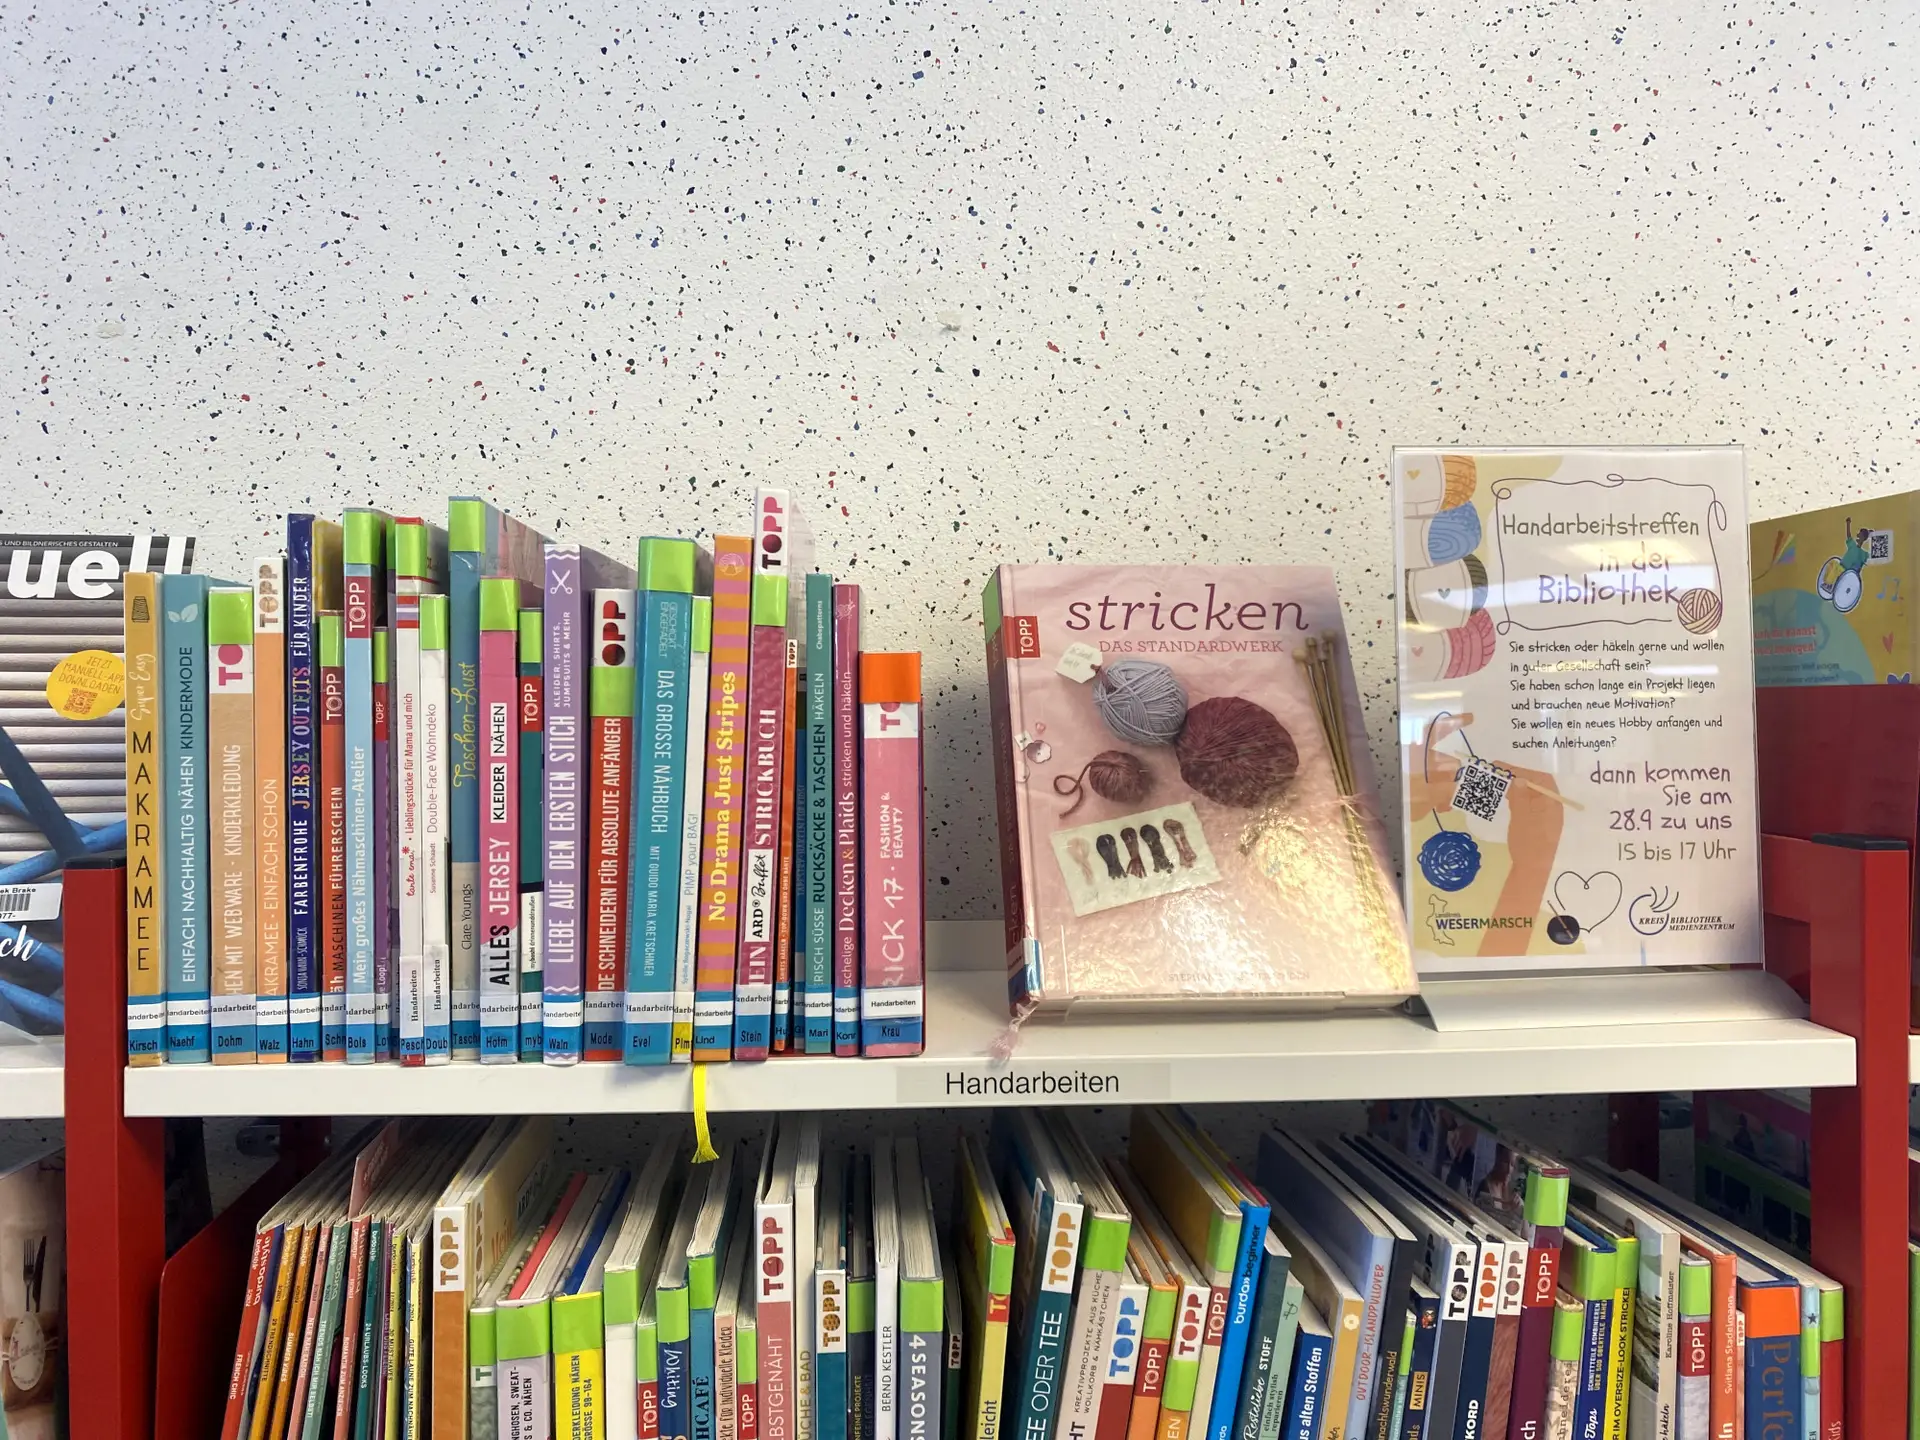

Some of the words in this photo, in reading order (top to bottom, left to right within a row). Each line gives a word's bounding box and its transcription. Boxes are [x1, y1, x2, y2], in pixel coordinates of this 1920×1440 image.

[22, 541, 78, 549] BILDNERISCHES
[762, 496, 783, 570] TOPP
[1502, 511, 1700, 536] Handarbeitstreffen
[1599, 549, 1620, 573] in
[1632, 541, 1670, 573] der
[258, 564, 279, 629] TOPP
[292, 577, 308, 627] KINDER
[349, 582, 366, 632] TOPP
[1065, 583, 1310, 631] stricken
[1539, 573, 1680, 605] Bibliothek
[553, 622, 562, 660] SHIRTS,
[564, 612, 572, 639] MEHR
[1098, 640, 1134, 653] DAS
[1137, 639, 1286, 653] STANDARDWERK
[1509, 641, 1525, 653] Sie
[1528, 641, 1571, 653] stricken
[1575, 640, 1599, 652] oder
[1602, 641, 1635, 653] häkeln
[1638, 641, 1667, 658] gerne
[1670, 640, 1689, 652] und
[1692, 640, 1725, 652] wollen
[58, 672, 121, 695] DOWNLOADEN
[553, 663, 562, 708] KLEIDER,
[564, 652, 572, 709] JUMPSUITS
[657, 670, 675, 699] DAS
[1510, 661, 1520, 673] in
[1523, 661, 1553, 677] guter
[1555, 657, 1622, 673] Gesellschaft
[1624, 659, 1652, 672] sein?
[1510, 679, 1526, 692] Sie
[1529, 679, 1561, 692] haben
[1564, 679, 1595, 691] schon
[1598, 679, 1625, 695] lange
[1628, 679, 1643, 691] ein
[1646, 678, 1684, 694] Projekt
[1687, 678, 1716, 694] liegen
[178, 647, 196, 750] KINDERMODE
[291, 667, 311, 736] OUTFITS
[326, 673, 342, 721] TOPP
[524, 683, 538, 724] TOPP
[715, 671, 739, 750] Stripes
[812, 673, 826, 720] HÄKELN
[1511, 698, 1530, 711] und
[1534, 698, 1583, 711] brauchen
[1586, 700, 1611, 710] neue
[1614, 697, 1676, 710] Motivation?
[426, 704, 439, 763] Wohndeko
[490, 706, 506, 754] NÄHEN
[548, 715, 576, 762] STICH
[655, 703, 674, 759] GROSSE
[1511, 718, 1527, 730] Sie
[1530, 718, 1563, 730] wollen
[1567, 718, 1582, 729] ein
[1585, 718, 1616, 729] neues
[1619, 716, 1653, 732] Hobby
[1656, 716, 1701, 732] anfangen
[1704, 716, 1723, 729] und
[1512, 737, 1549, 749] suchen
[1552, 735, 1617, 752] Anleitungen?
[291, 741, 310, 810] JERSEY
[601, 718, 621, 788] ANFÄNGER
[813, 724, 827, 794] TASCHEN
[841, 741, 853, 787] stricken
[1590, 760, 1636, 785] dann
[1645, 761, 1731, 784] kommen
[177, 756, 196, 809] NÄHEN
[222, 744, 243, 857] KINDERKLEIDUNG
[492, 765, 506, 821] KLEIDER
[548, 772, 576, 831] ERSTEN
[651, 765, 672, 834] NÄHBUCH
[713, 756, 732, 805] Just
[754, 709, 776, 847] STRICKBUCH
[1663, 784, 1692, 806] Sie
[1700, 791, 1732, 805] am
[350, 746, 367, 896] Nähmaschinen-Atelier
[404, 771, 417, 834] Lieblingsstücke
[600, 790, 621, 857] ABSOLUTE
[837, 792, 856, 845] Plaids
[1609, 808, 1652, 831] 28.9
[1661, 816, 1687, 831] zu
[1695, 815, 1732, 831] uns
[132, 731, 154, 970] MAKRAMEE
[329, 786, 343, 890] FÜHRERSCHEIN
[548, 840, 576, 870] DEN
[710, 810, 731, 887] Drama
[810, 811, 827, 904] RUCKSÄCKE
[1644, 841, 1672, 862] bis
[1680, 842, 1696, 860] 17
[1703, 840, 1737, 860] Uhr
[180, 814, 196, 911] NACHHALTIG
[262, 842, 279, 910] EINFACH
[293, 819, 308, 915] FARBENFROHE
[489, 837, 511, 916] JERSEY
[750, 854, 770, 899] Buffet
[223, 871, 243, 939] WEBWARE
[548, 880, 575, 910] AUF
[710, 891, 727, 921] No
[838, 863, 855, 931] Decken
[332, 894, 345, 972] MASCHINEN
[548, 919, 575, 963] LIEBE
[598, 888, 618, 970] SCHNEIDERN
[752, 908, 766, 939] ARD
[1435, 916, 1534, 931] WESERMARSCH
[1639, 916, 1665, 925] KREIS
[1668, 924, 1736, 932] MEDIENZENTRUM
[1670, 916, 1723, 925] BIBLIOTHEK
[181, 918, 197, 982] EINFACH
[352, 950, 367, 984] Mein
[489, 924, 510, 986] ALLES
[129, 1039, 158, 1052] Kirsch
[259, 1039, 281, 1051] Walz
[741, 1030, 763, 1043] Stein
[881, 1025, 901, 1037] Krau
[946, 1071, 1119, 1095] Handarbeiten
[440, 1216, 459, 1286] TOPP
[762, 1216, 784, 1296] TOPP
[1048, 1212, 1076, 1285] TOPP
[1448, 1251, 1472, 1318] TOPP
[1477, 1252, 1499, 1312] TOPP
[1503, 1250, 1524, 1310] TOPP
[1536, 1252, 1553, 1303] TOPP
[1665, 1271, 1676, 1320] Hoffmeister
[822, 1279, 840, 1348] TOPP
[1039, 1310, 1063, 1350] TEE
[1108, 1297, 1140, 1378] TOPP
[1178, 1293, 1203, 1356] TOPP
[1355, 1264, 1385, 1401] OUTDOOR-ISLANDPULLOVER
[1724, 1295, 1735, 1355] Stadelmann
[261, 1327, 277, 1382] TRENDSCHNITTE
[718, 1326, 732, 1356] Kleider
[881, 1325, 892, 1371] KESTLER
[1258, 1336, 1273, 1371] STOFF
[1664, 1323, 1675, 1359] Karoline
[1691, 1326, 1706, 1373] TOPP
[521, 1377, 533, 1406] NÄHEN
[568, 1355, 581, 1384] NÄHEN
[719, 1359, 733, 1405] individuelle
[881, 1375, 892, 1412] BERND
[1031, 1355, 1056, 1411] ODER
[1074, 1327, 1094, 1414] KREATIVPROJEKTE
[1304, 1347, 1323, 1393] Stoffen
[1413, 1373, 1426, 1408] MINIS
[1613, 1335, 1627, 1417] OVERSIZE-LOOK
[1723, 1356, 1735, 1395] Svitlana
[1298, 1395, 1315, 1427] alten
